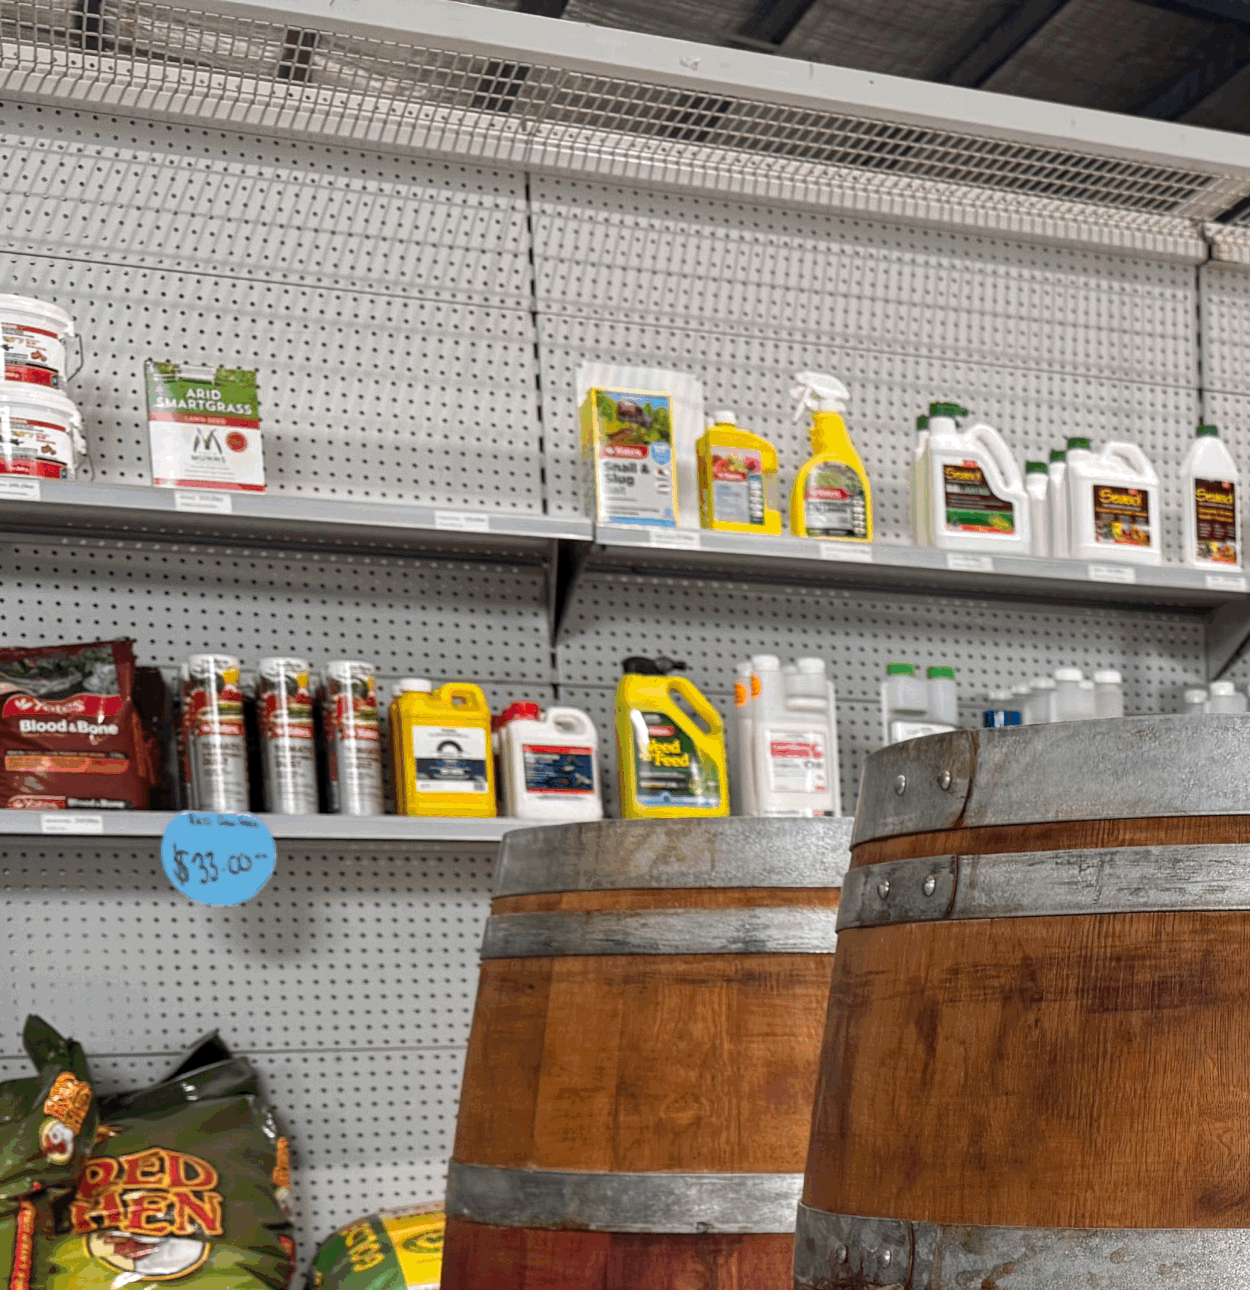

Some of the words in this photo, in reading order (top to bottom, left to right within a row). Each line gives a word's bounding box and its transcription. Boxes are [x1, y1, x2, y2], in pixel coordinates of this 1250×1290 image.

[186, 388, 221, 400] ARID
[155, 396, 252, 415] SMARTGRASS
[19, 719, 67, 732] Blood
[77, 720, 119, 735] Bone
[78, 1147, 218, 1199] RED
[71, 1188, 223, 1236] HEN
